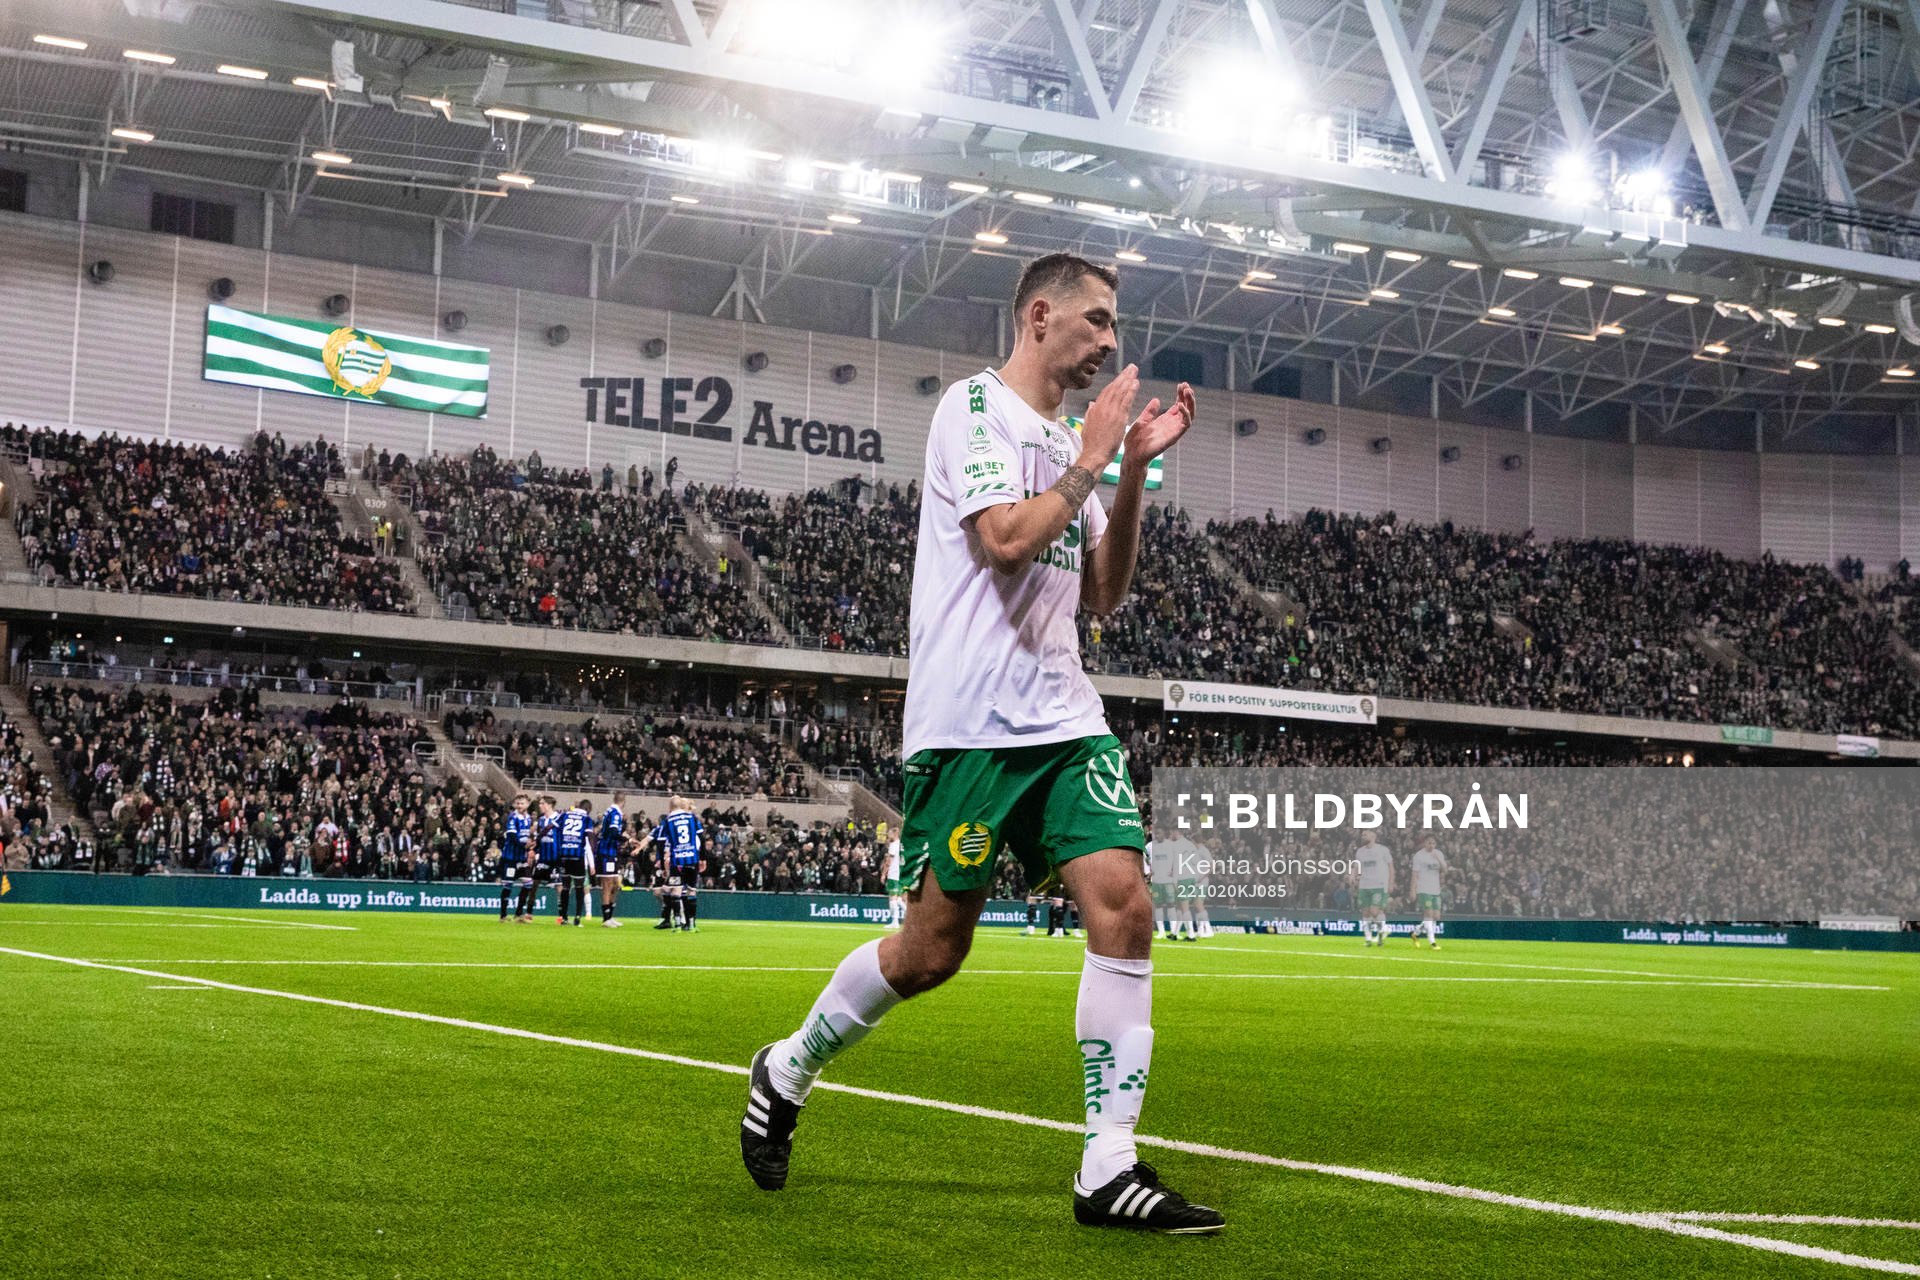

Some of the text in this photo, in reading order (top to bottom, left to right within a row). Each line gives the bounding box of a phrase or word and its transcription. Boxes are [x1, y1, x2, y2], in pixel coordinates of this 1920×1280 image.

[967, 379, 986, 414] BS
[580, 376, 885, 464] TELE2 Arena
[1189, 692, 1358, 714] FÖR EN POSITIV SUPPORTERKULTUR
[562, 818, 583, 837] 22
[677, 825, 690, 844] 3
[260, 888, 320, 904] Ladda
[327, 893, 362, 909] upp
[367, 891, 414, 906] inför
[810, 903, 858, 918] Ladda
[863, 908, 891, 922] upp
[1325, 919, 1356, 931] inför
[1623, 928, 1788, 945] Ladda upp inför hemmamatch!
